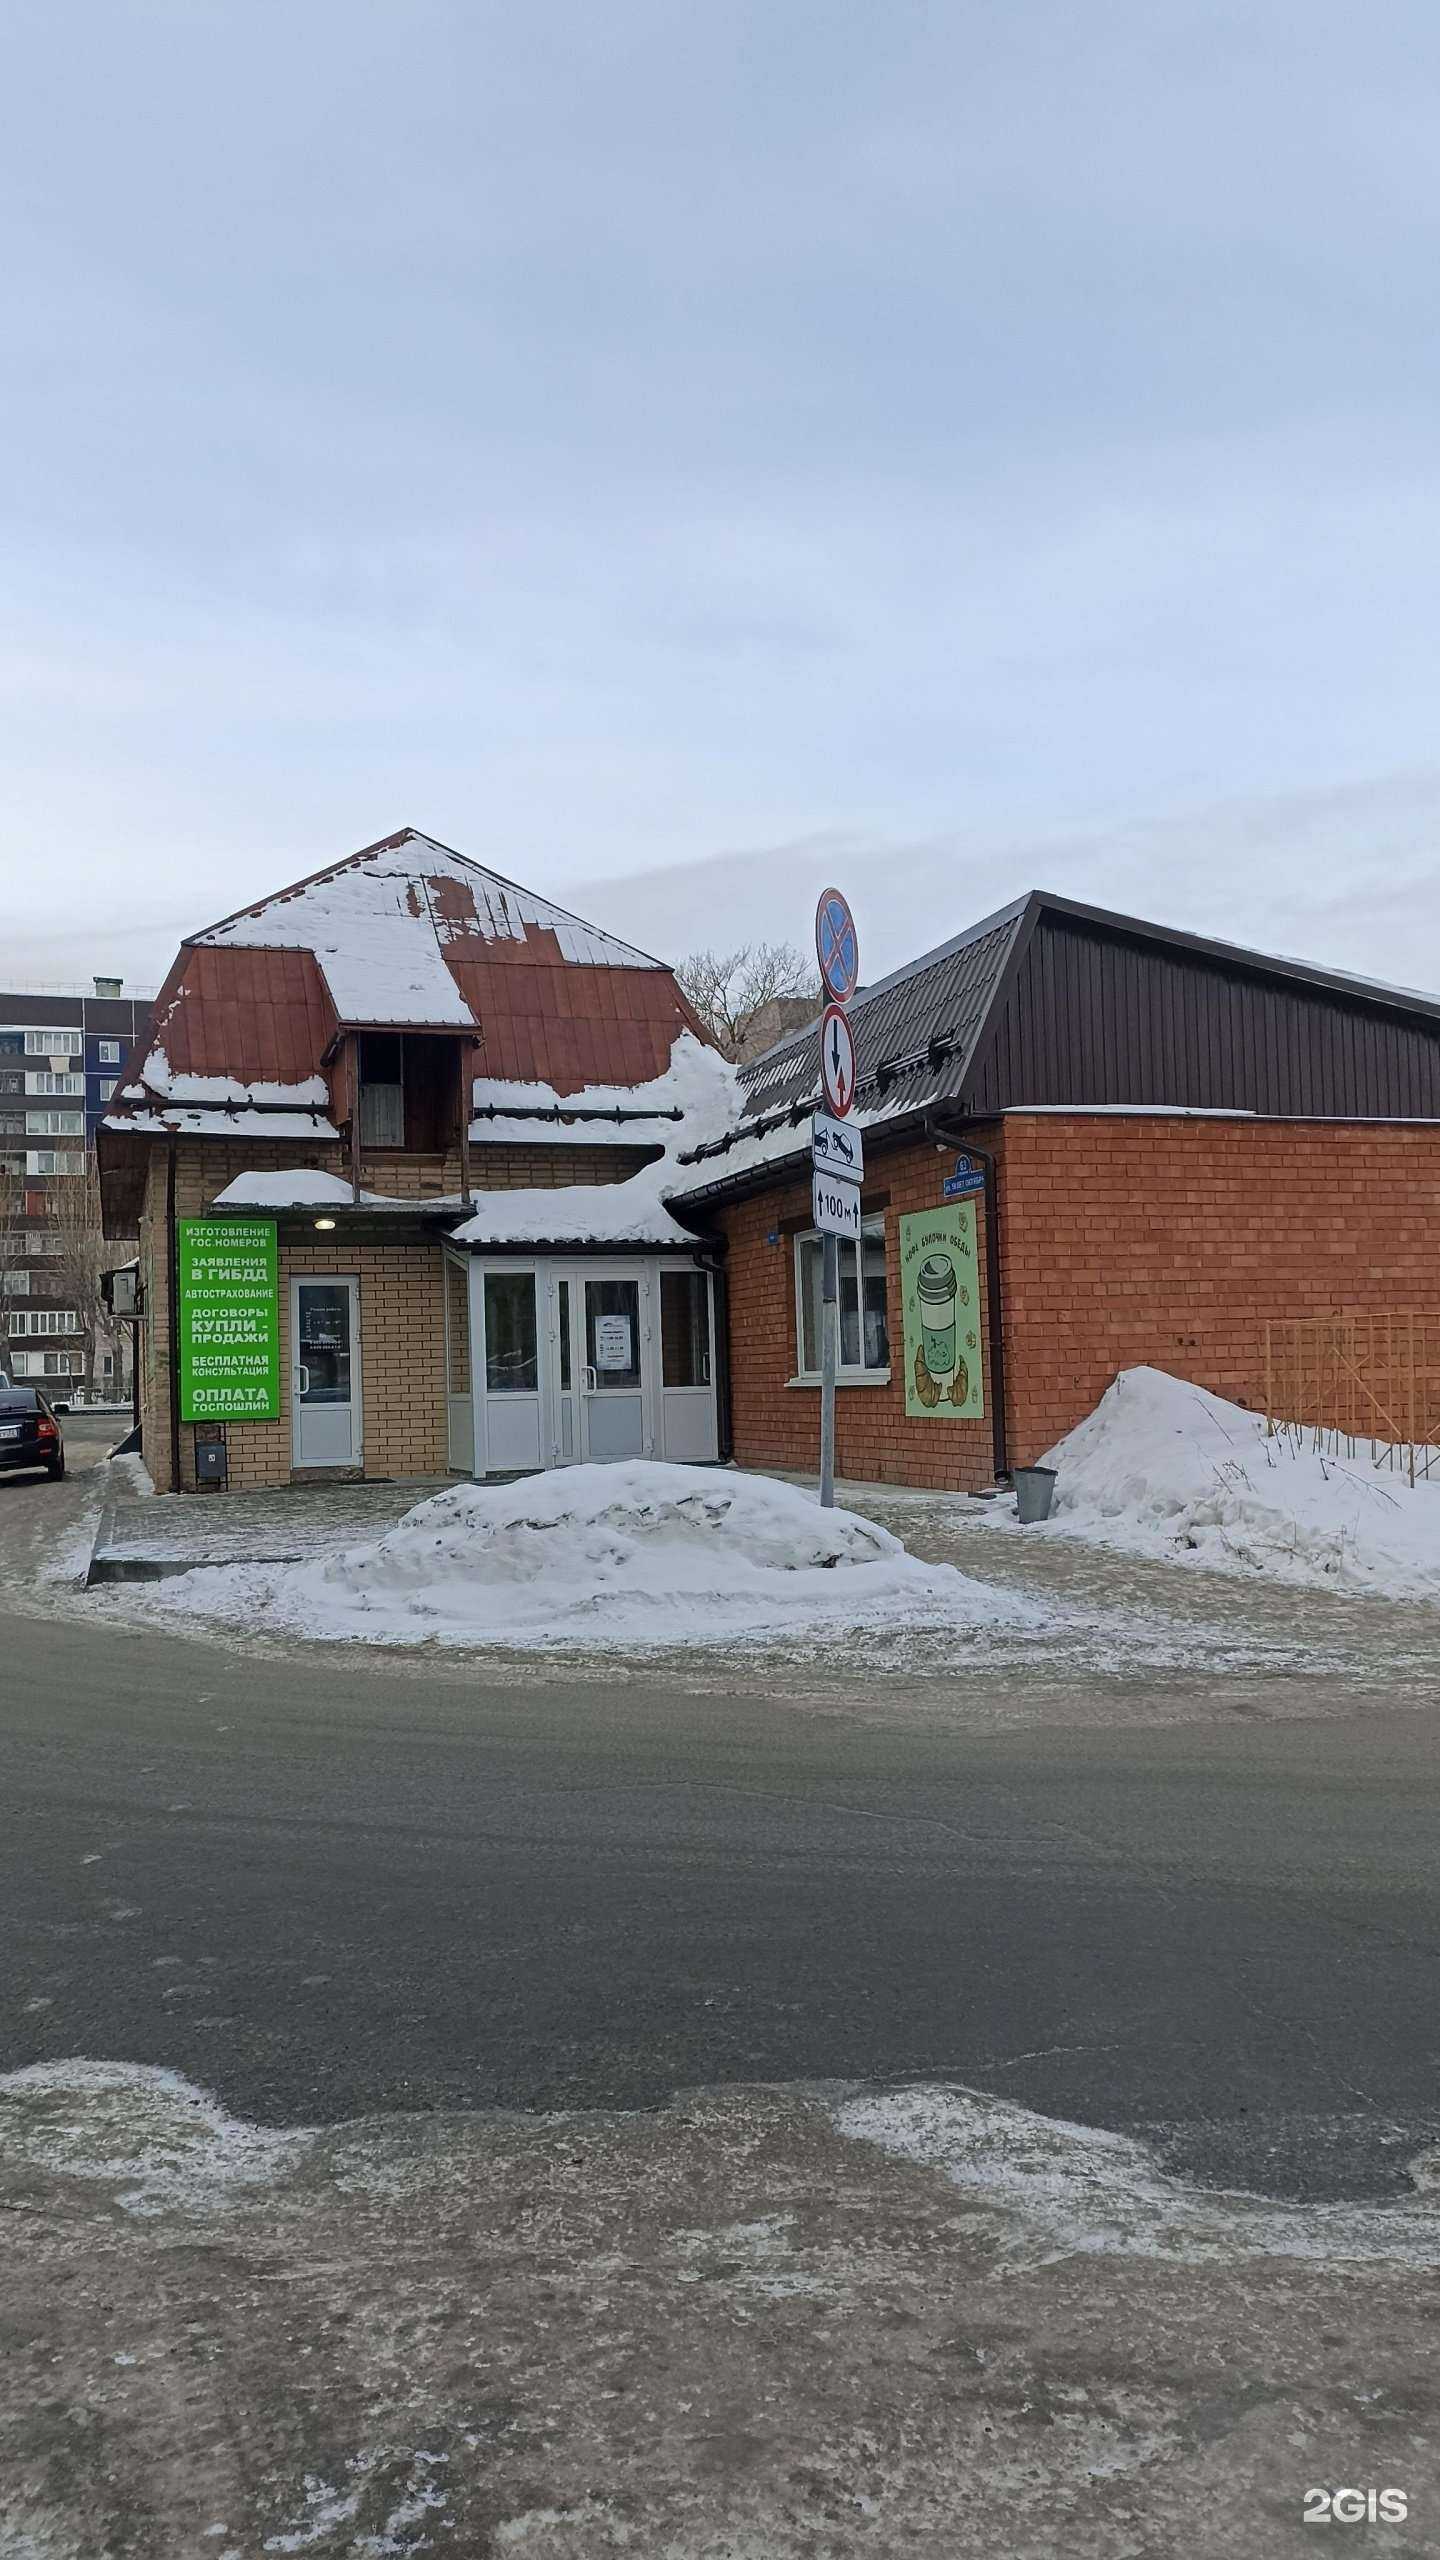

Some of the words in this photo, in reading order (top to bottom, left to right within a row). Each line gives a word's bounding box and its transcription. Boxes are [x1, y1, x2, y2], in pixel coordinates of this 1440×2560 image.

[825, 1194, 843, 1218] 100
[186, 1227, 271, 1237] ИЗГОТОВЛЕНИЕ
[949, 1234, 971, 1257] ОБЕДЫ
[191, 1257, 267, 1267] ЗАЯВЛЕНИЯ
[191, 1268, 203, 1280] В
[208, 1268, 268, 1282] ГИБДД
[184, 1288, 274, 1299] АВТОСТРАХОВАНИЕ
[191, 1308, 268, 1319] ДОГОВОРЫ
[191, 1320, 256, 1332] КУПЛИ
[191, 1333, 269, 1344] ПРОДАЖИ
[191, 1355, 269, 1367] БЕСПЛАТНАЯ
[191, 1366, 269, 1377] КОНСУЛЬТАЦИЯ
[192, 1387, 269, 1402] ОПЛАТА
[192, 1401, 270, 1412] ГОСПОШЛИН
